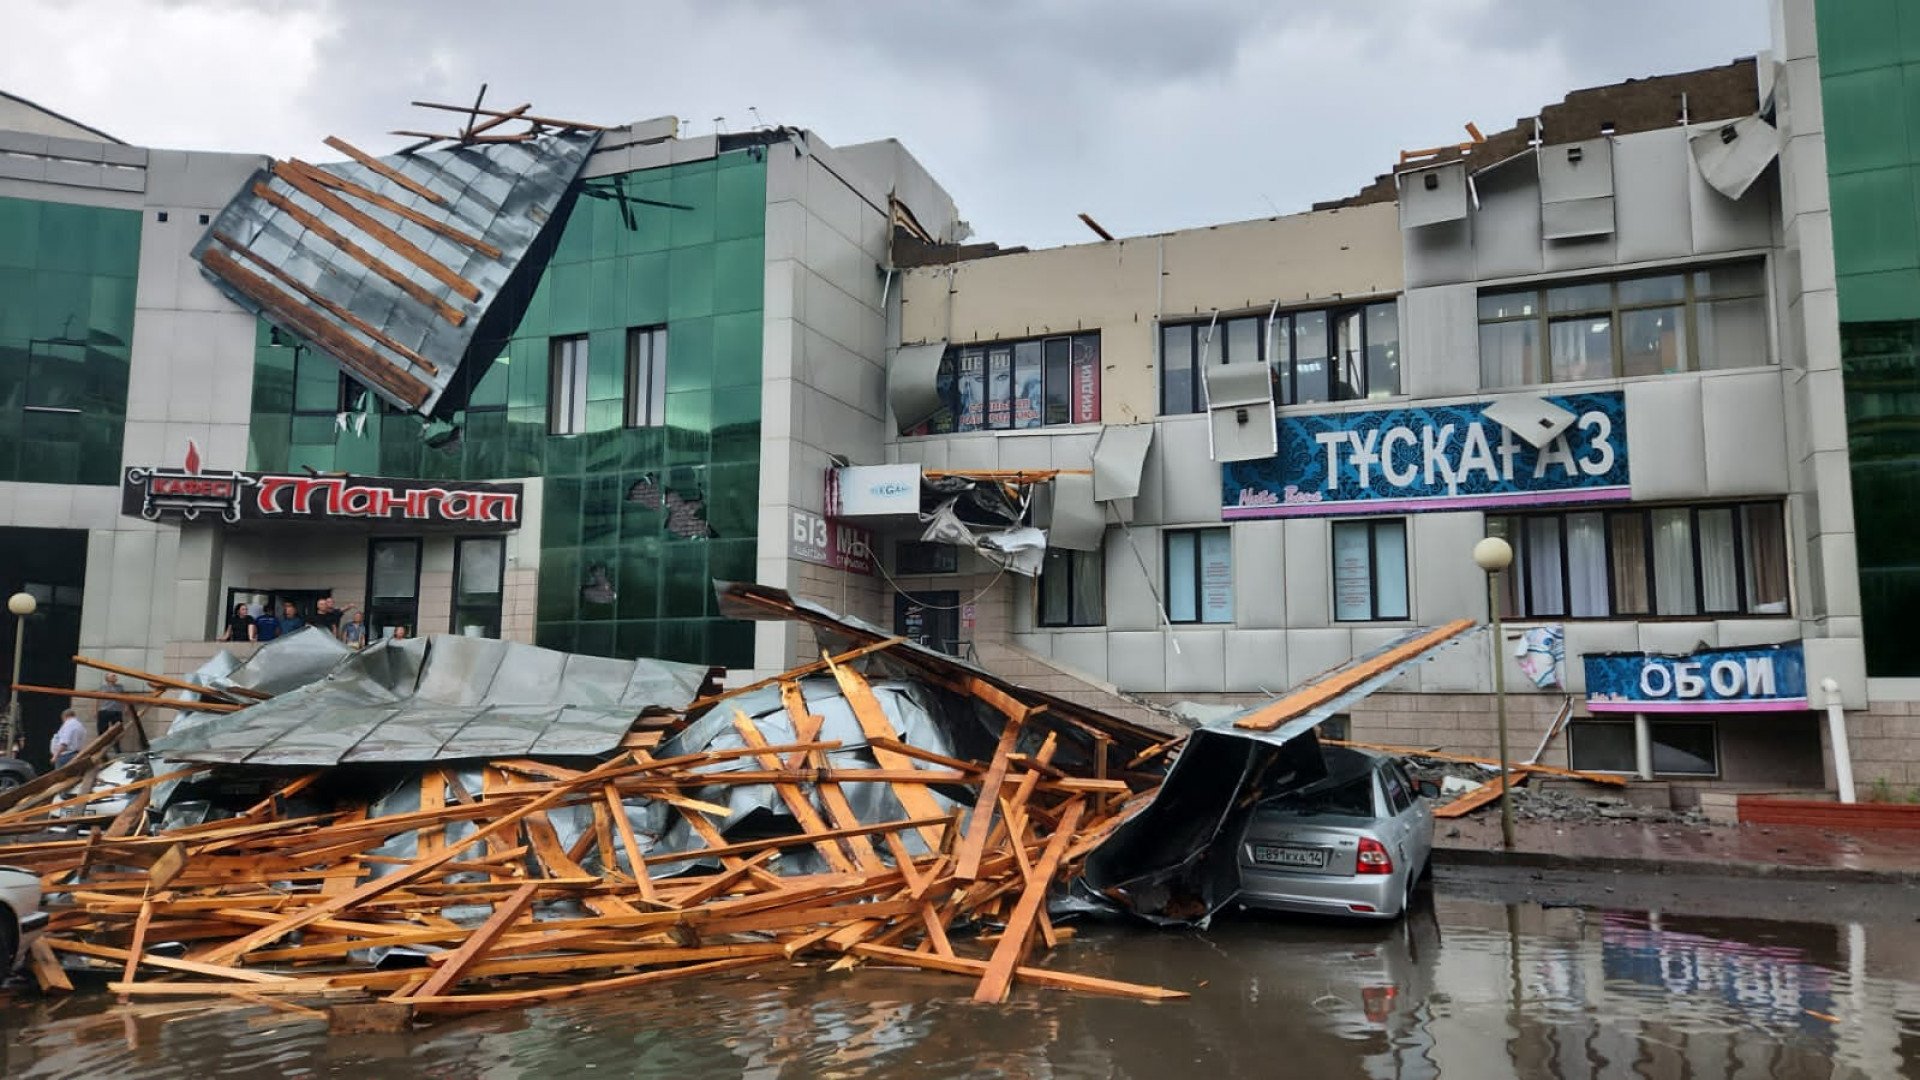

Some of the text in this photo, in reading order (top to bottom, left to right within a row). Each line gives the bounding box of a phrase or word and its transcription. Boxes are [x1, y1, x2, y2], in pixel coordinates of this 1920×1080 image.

[1081, 364, 1093, 421] СКИДКИ
[836, 525, 870, 560] МЫ
[1639, 656, 1777, 698] ОБОИ
